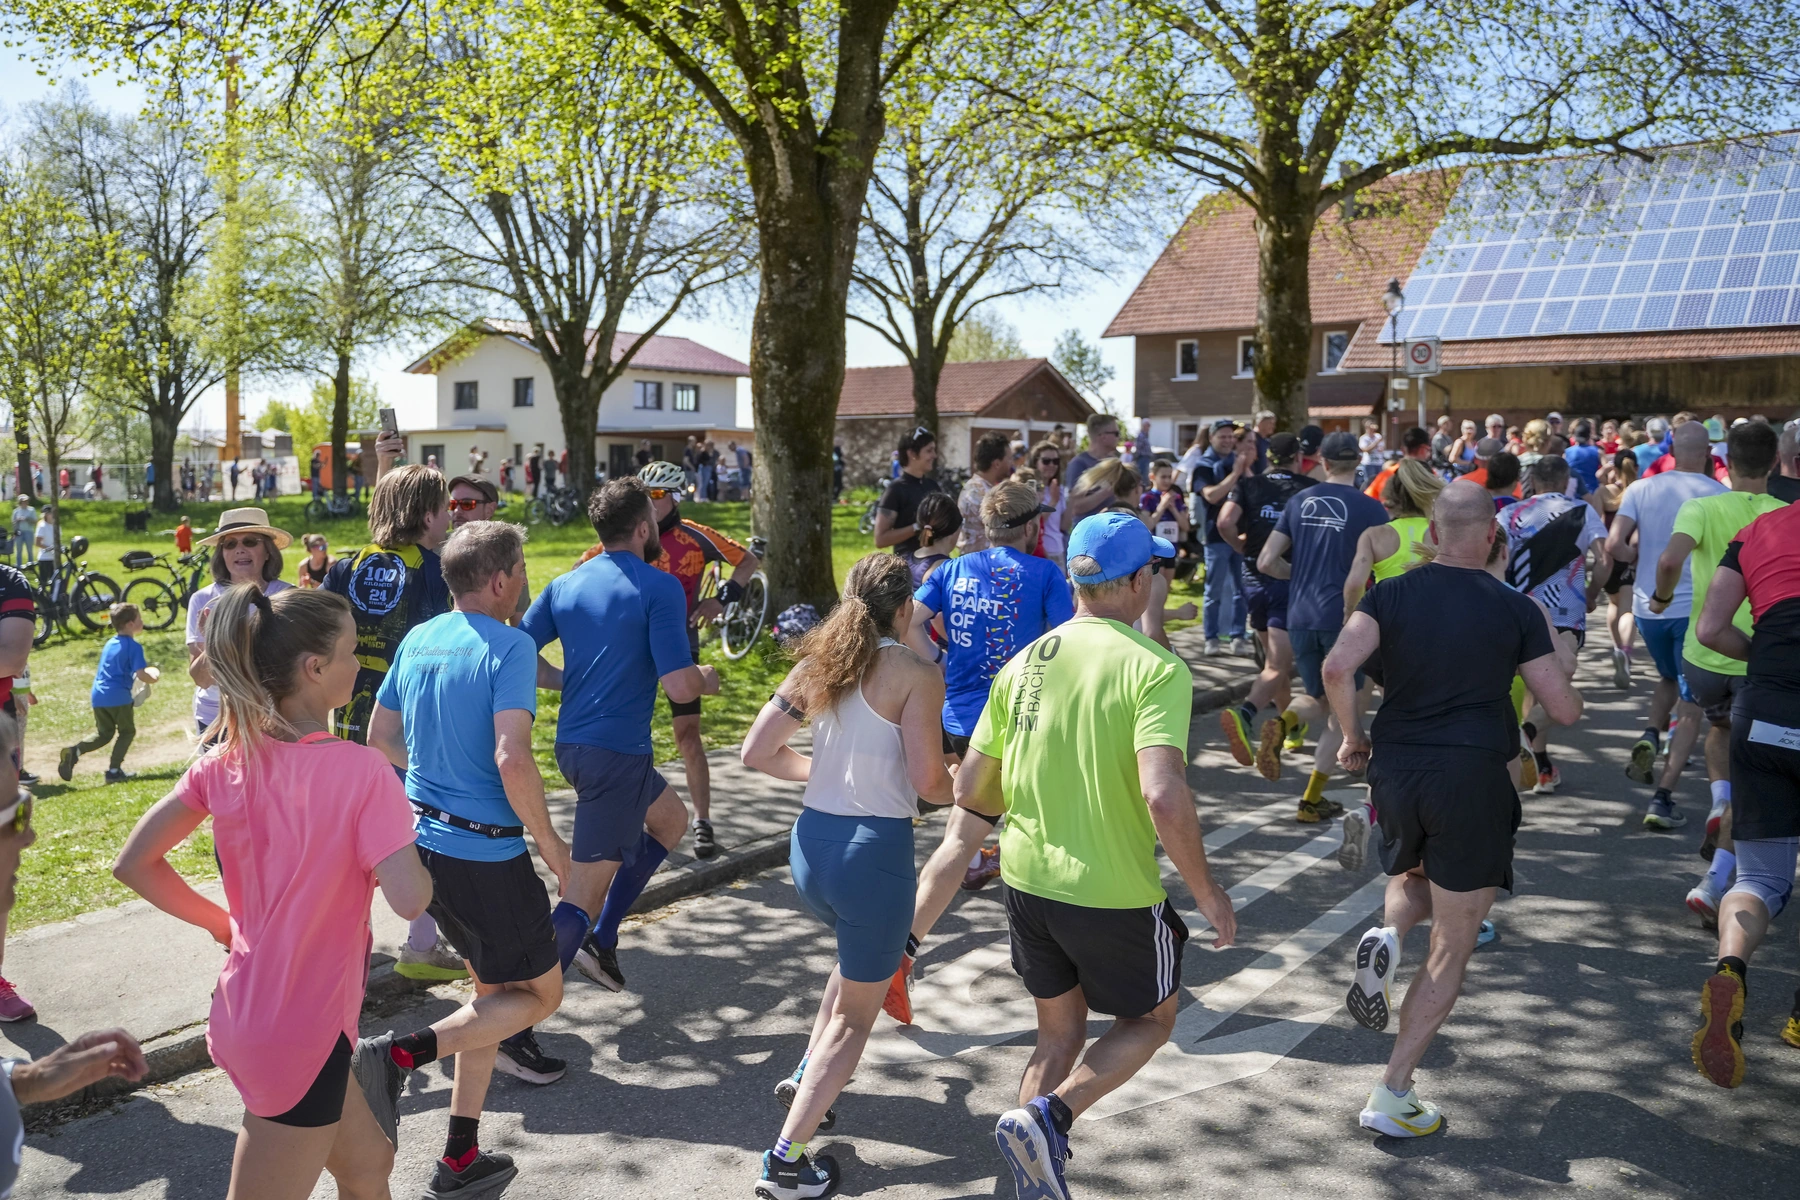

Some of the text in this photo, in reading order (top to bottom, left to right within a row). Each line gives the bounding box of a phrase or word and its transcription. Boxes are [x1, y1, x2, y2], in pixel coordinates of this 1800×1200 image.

[1415, 348, 1427, 358] 30
[364, 566, 398, 582] 100
[953, 577, 980, 594] BE
[369, 588, 387, 602] 24
[951, 593, 1004, 616] PART
[950, 611, 975, 629] OF
[950, 628, 973, 648] US
[1025, 634, 1062, 664] 10
[1014, 664, 1032, 715] FISCH
[1027, 664, 1047, 713] BACH
[1778, 737, 1796, 746] AOK
